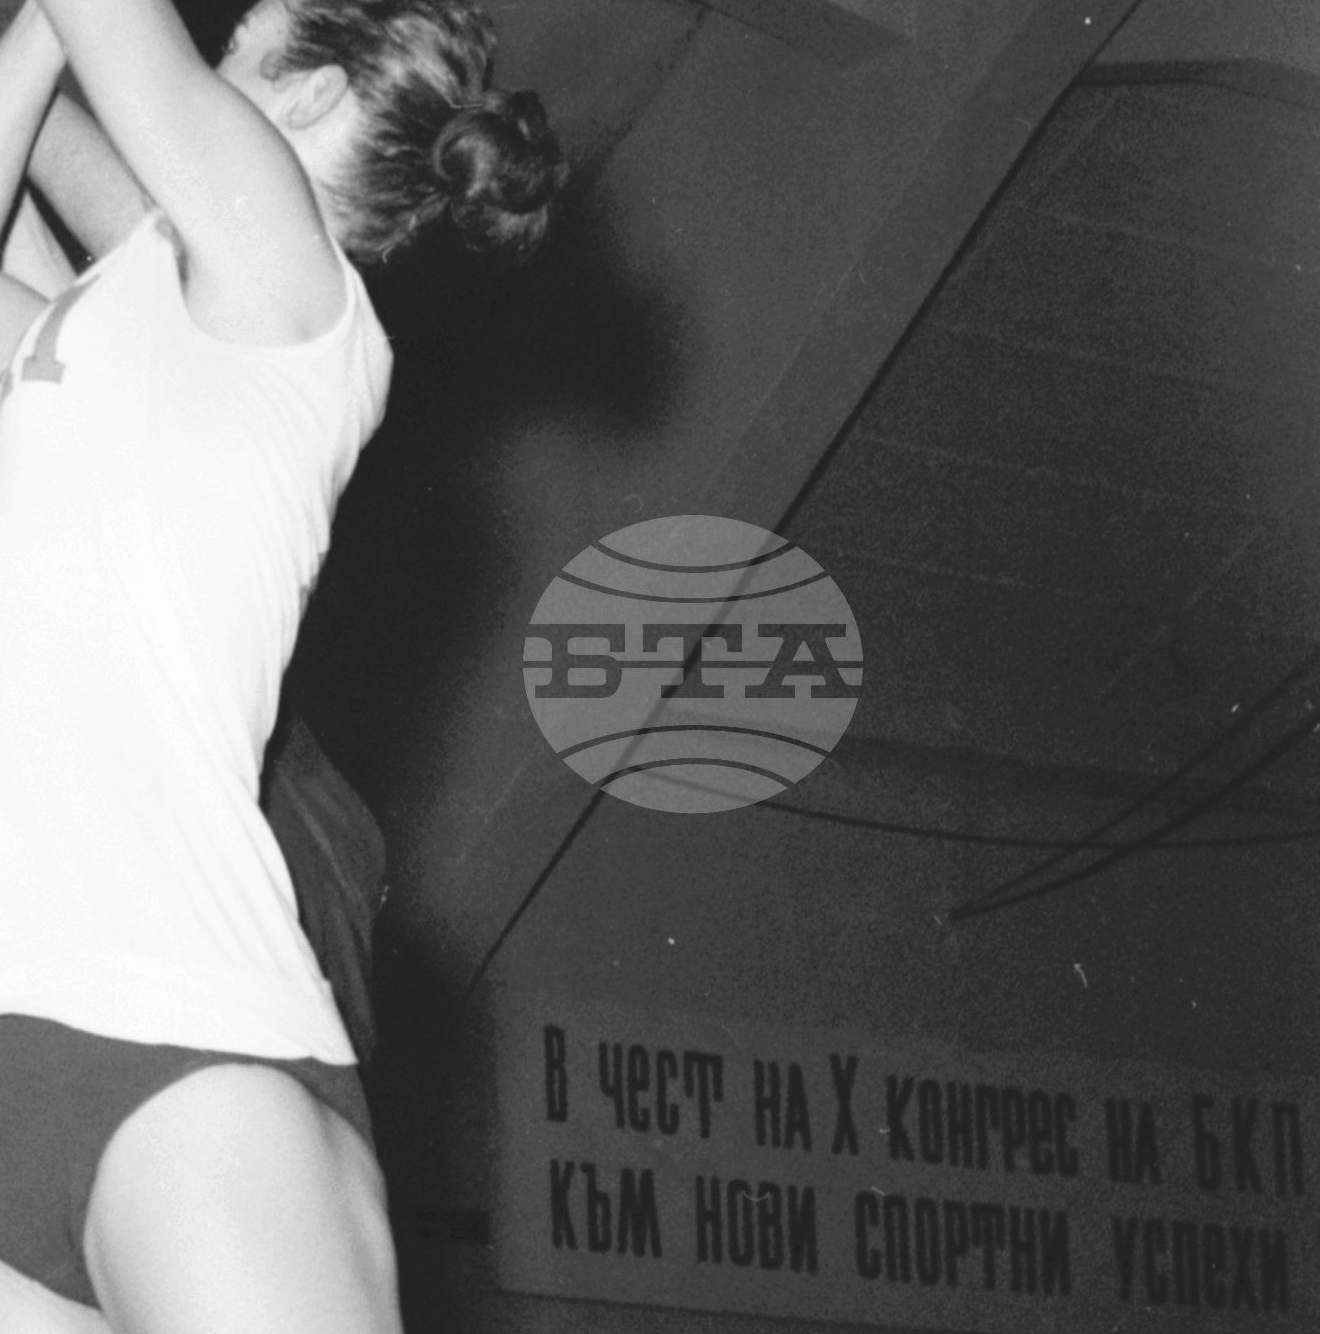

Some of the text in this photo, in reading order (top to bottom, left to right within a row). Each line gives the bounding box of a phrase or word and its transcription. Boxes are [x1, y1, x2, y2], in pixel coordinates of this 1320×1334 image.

[543, 1024, 568, 1122] В
[599, 1041, 724, 1140] ЧЕСТ
[754, 1058, 812, 1153] НА
[887, 1074, 1079, 1178] КОНГРЕС
[1104, 1097, 1160, 1185] НА
[1192, 1093, 1304, 1197] БКП
[550, 1159, 1289, 1313] КЪМ НОВИ СПОРТНИ УСПЕХИ
